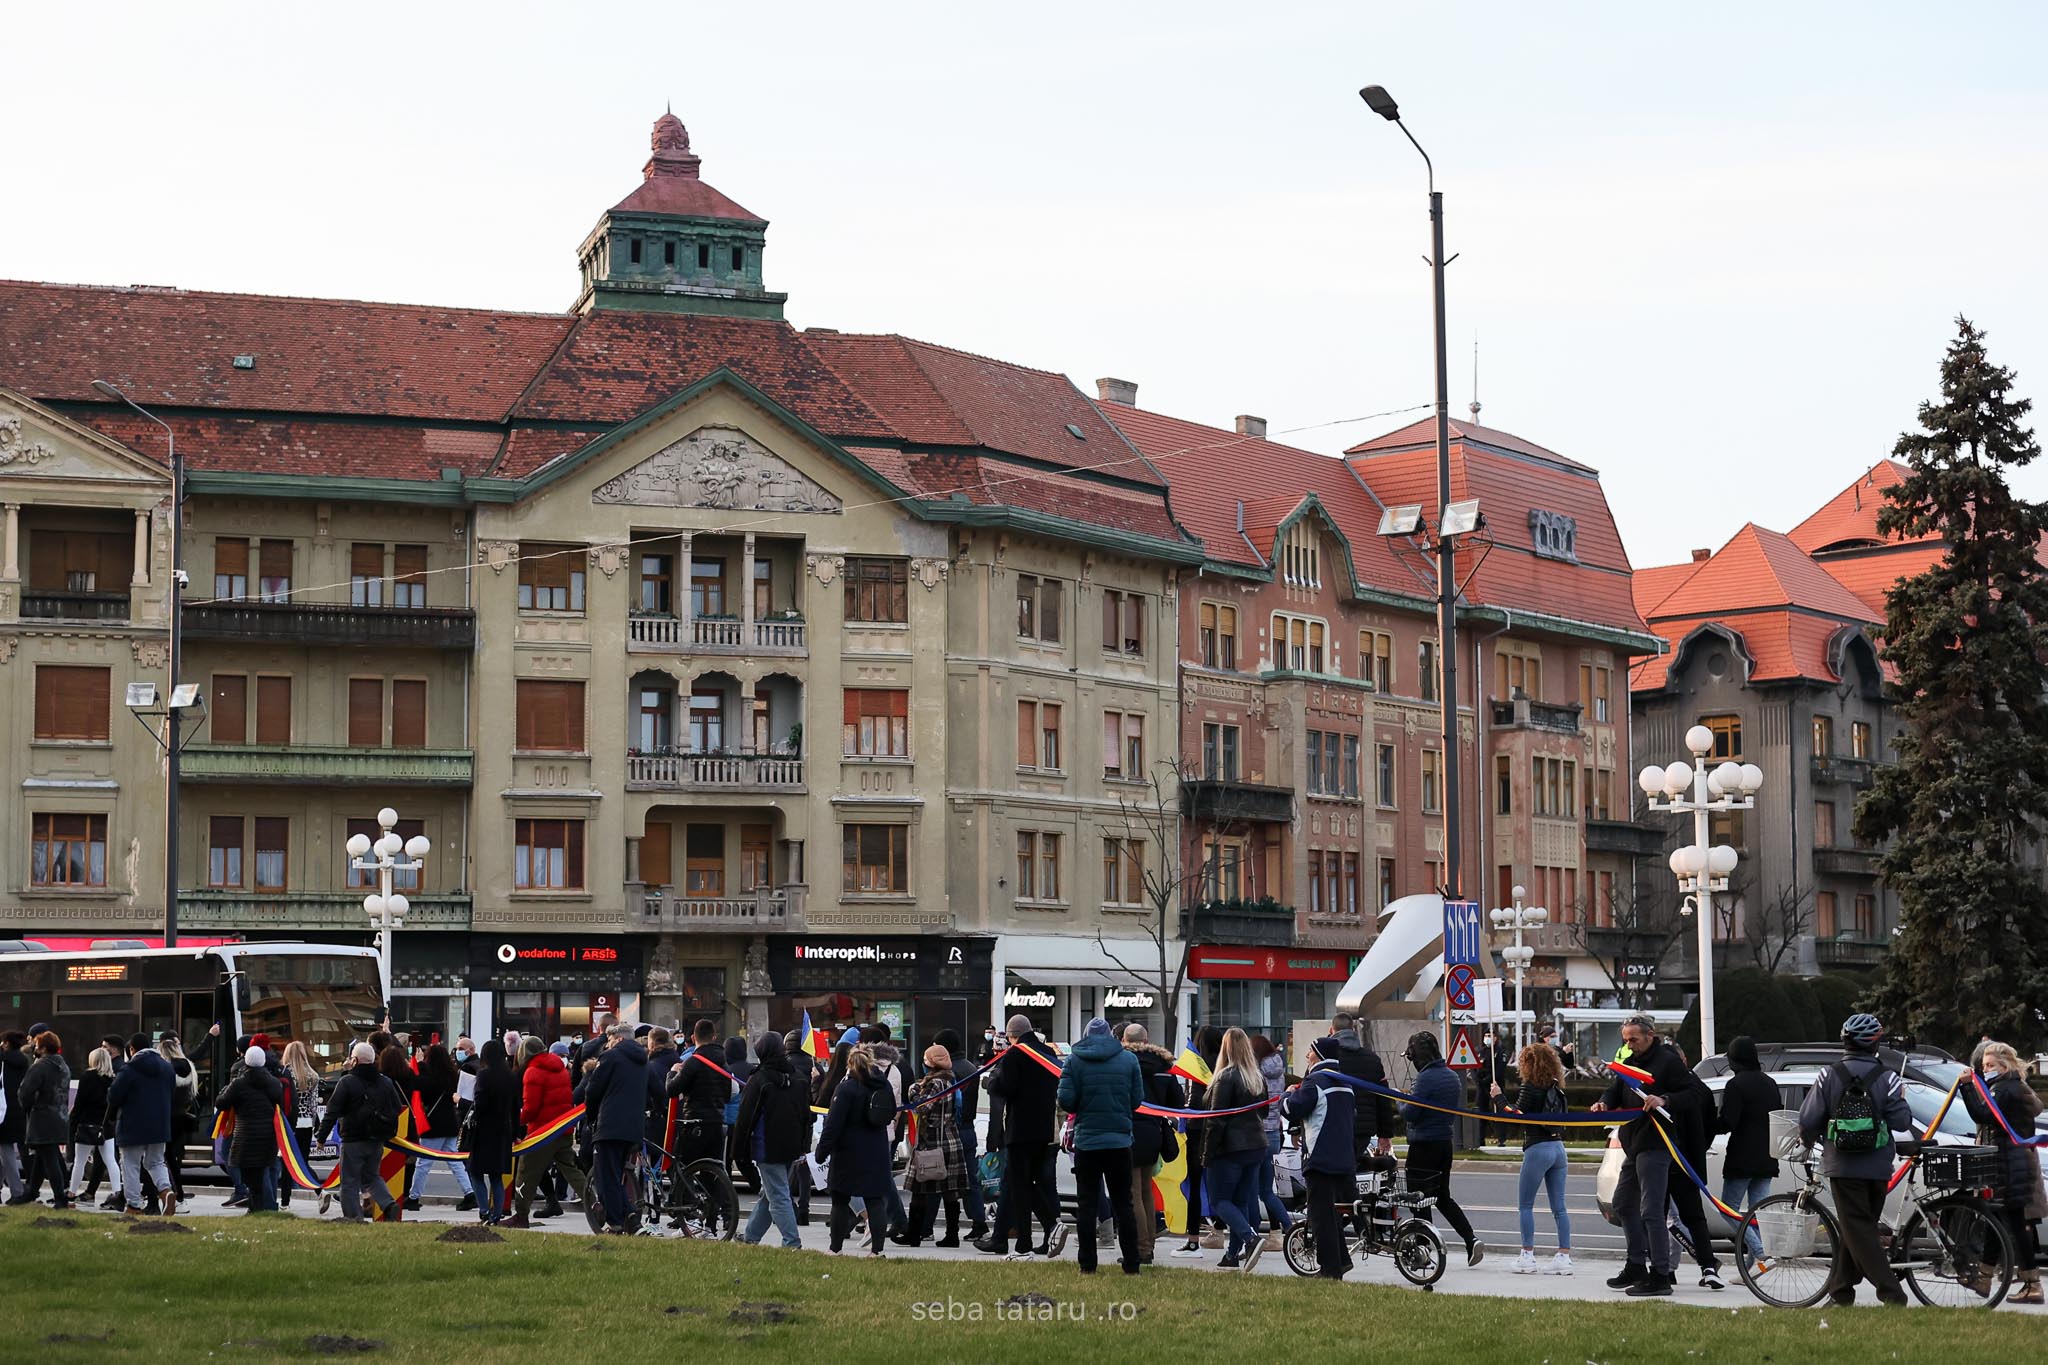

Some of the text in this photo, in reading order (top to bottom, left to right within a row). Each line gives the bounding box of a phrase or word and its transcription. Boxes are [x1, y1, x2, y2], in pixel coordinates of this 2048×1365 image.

[518, 948, 566, 958] vodafone
[804, 946, 916, 962] Interoptik SHOPS
[1004, 987, 1055, 1007] Marelbo
[1104, 988, 1153, 1008] Marelbo
